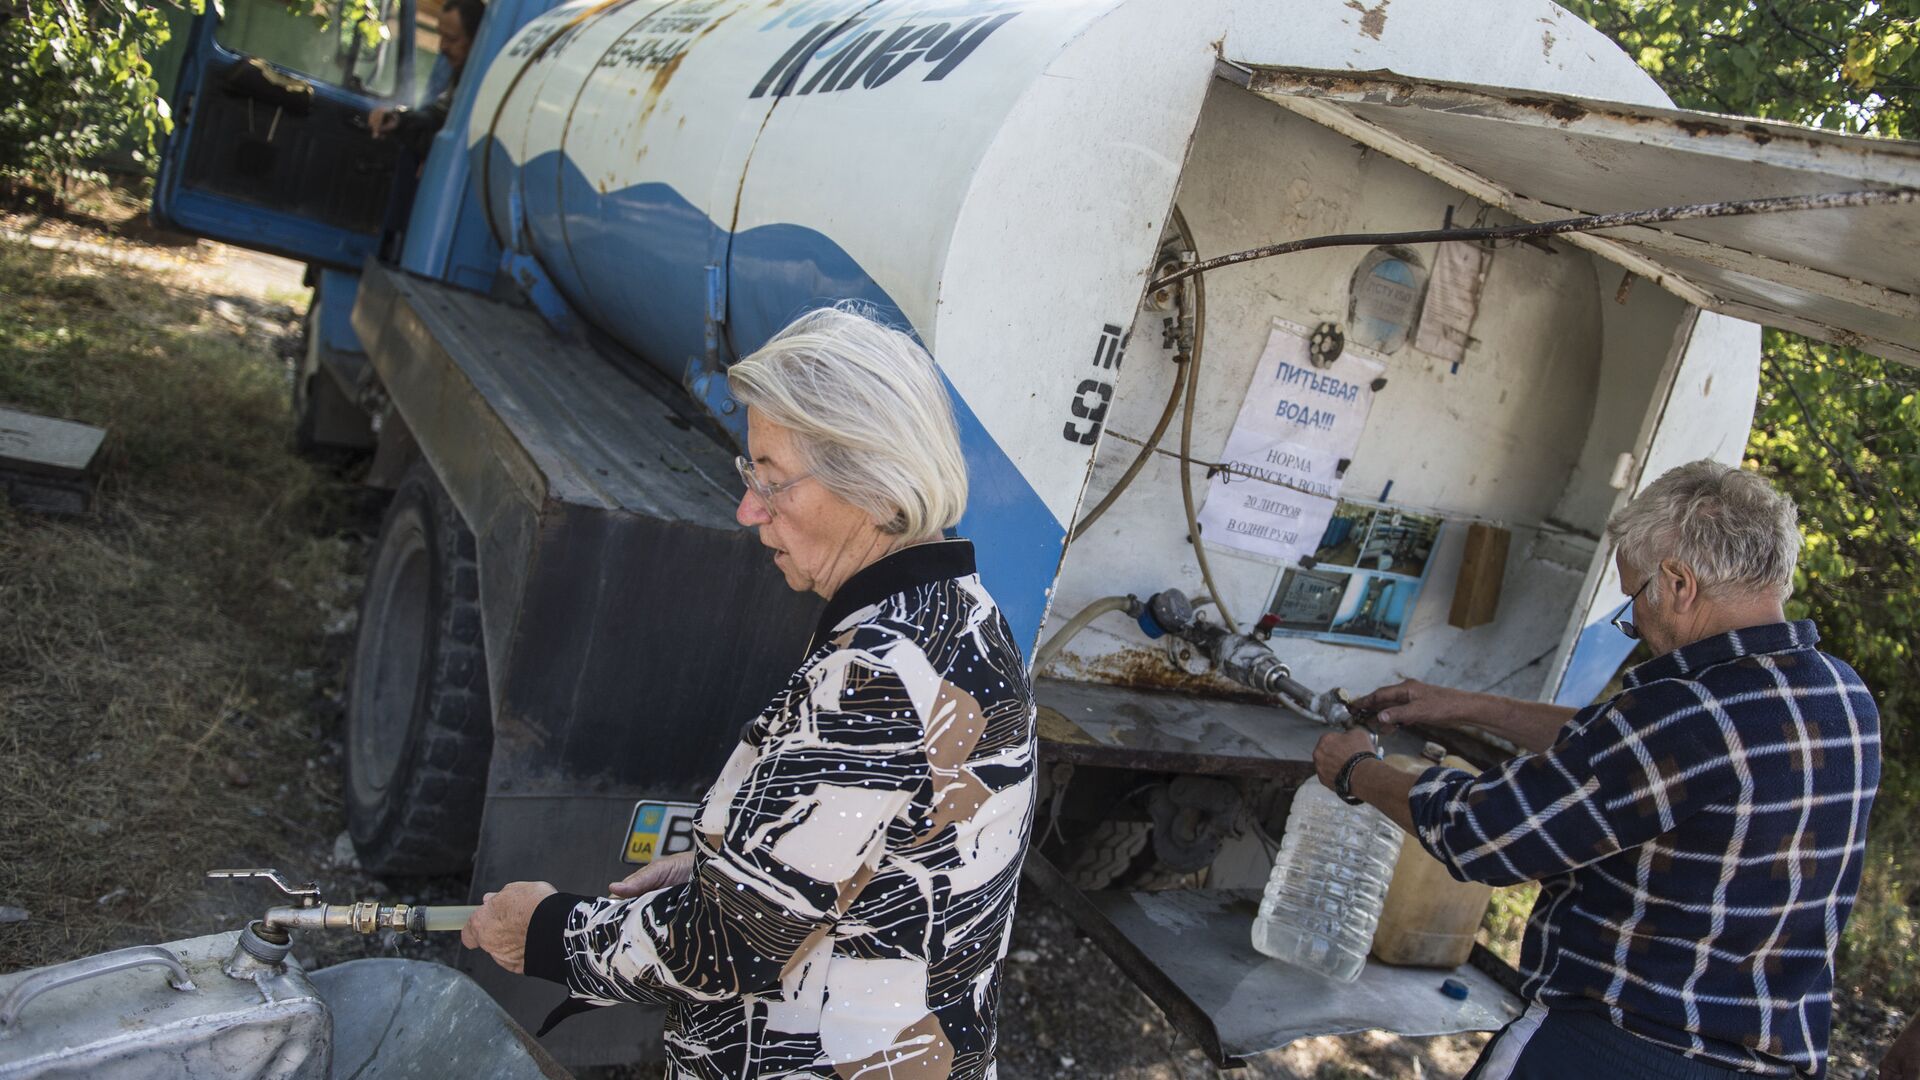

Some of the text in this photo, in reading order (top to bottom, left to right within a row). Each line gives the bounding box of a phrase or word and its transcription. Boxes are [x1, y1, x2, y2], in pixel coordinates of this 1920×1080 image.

[1276, 361, 1359, 402] ПИТЬЕВАЯ
[1275, 399, 1336, 431] ВОДА!!!
[1266, 449, 1312, 473] НОРМА
[1299, 479, 1332, 497] ВОДЫ
[1243, 495, 1301, 518] 20 ЛИТРОВ
[1226, 518, 1298, 544] В ОДНИ РУКИ
[632, 842, 652, 853] UA
